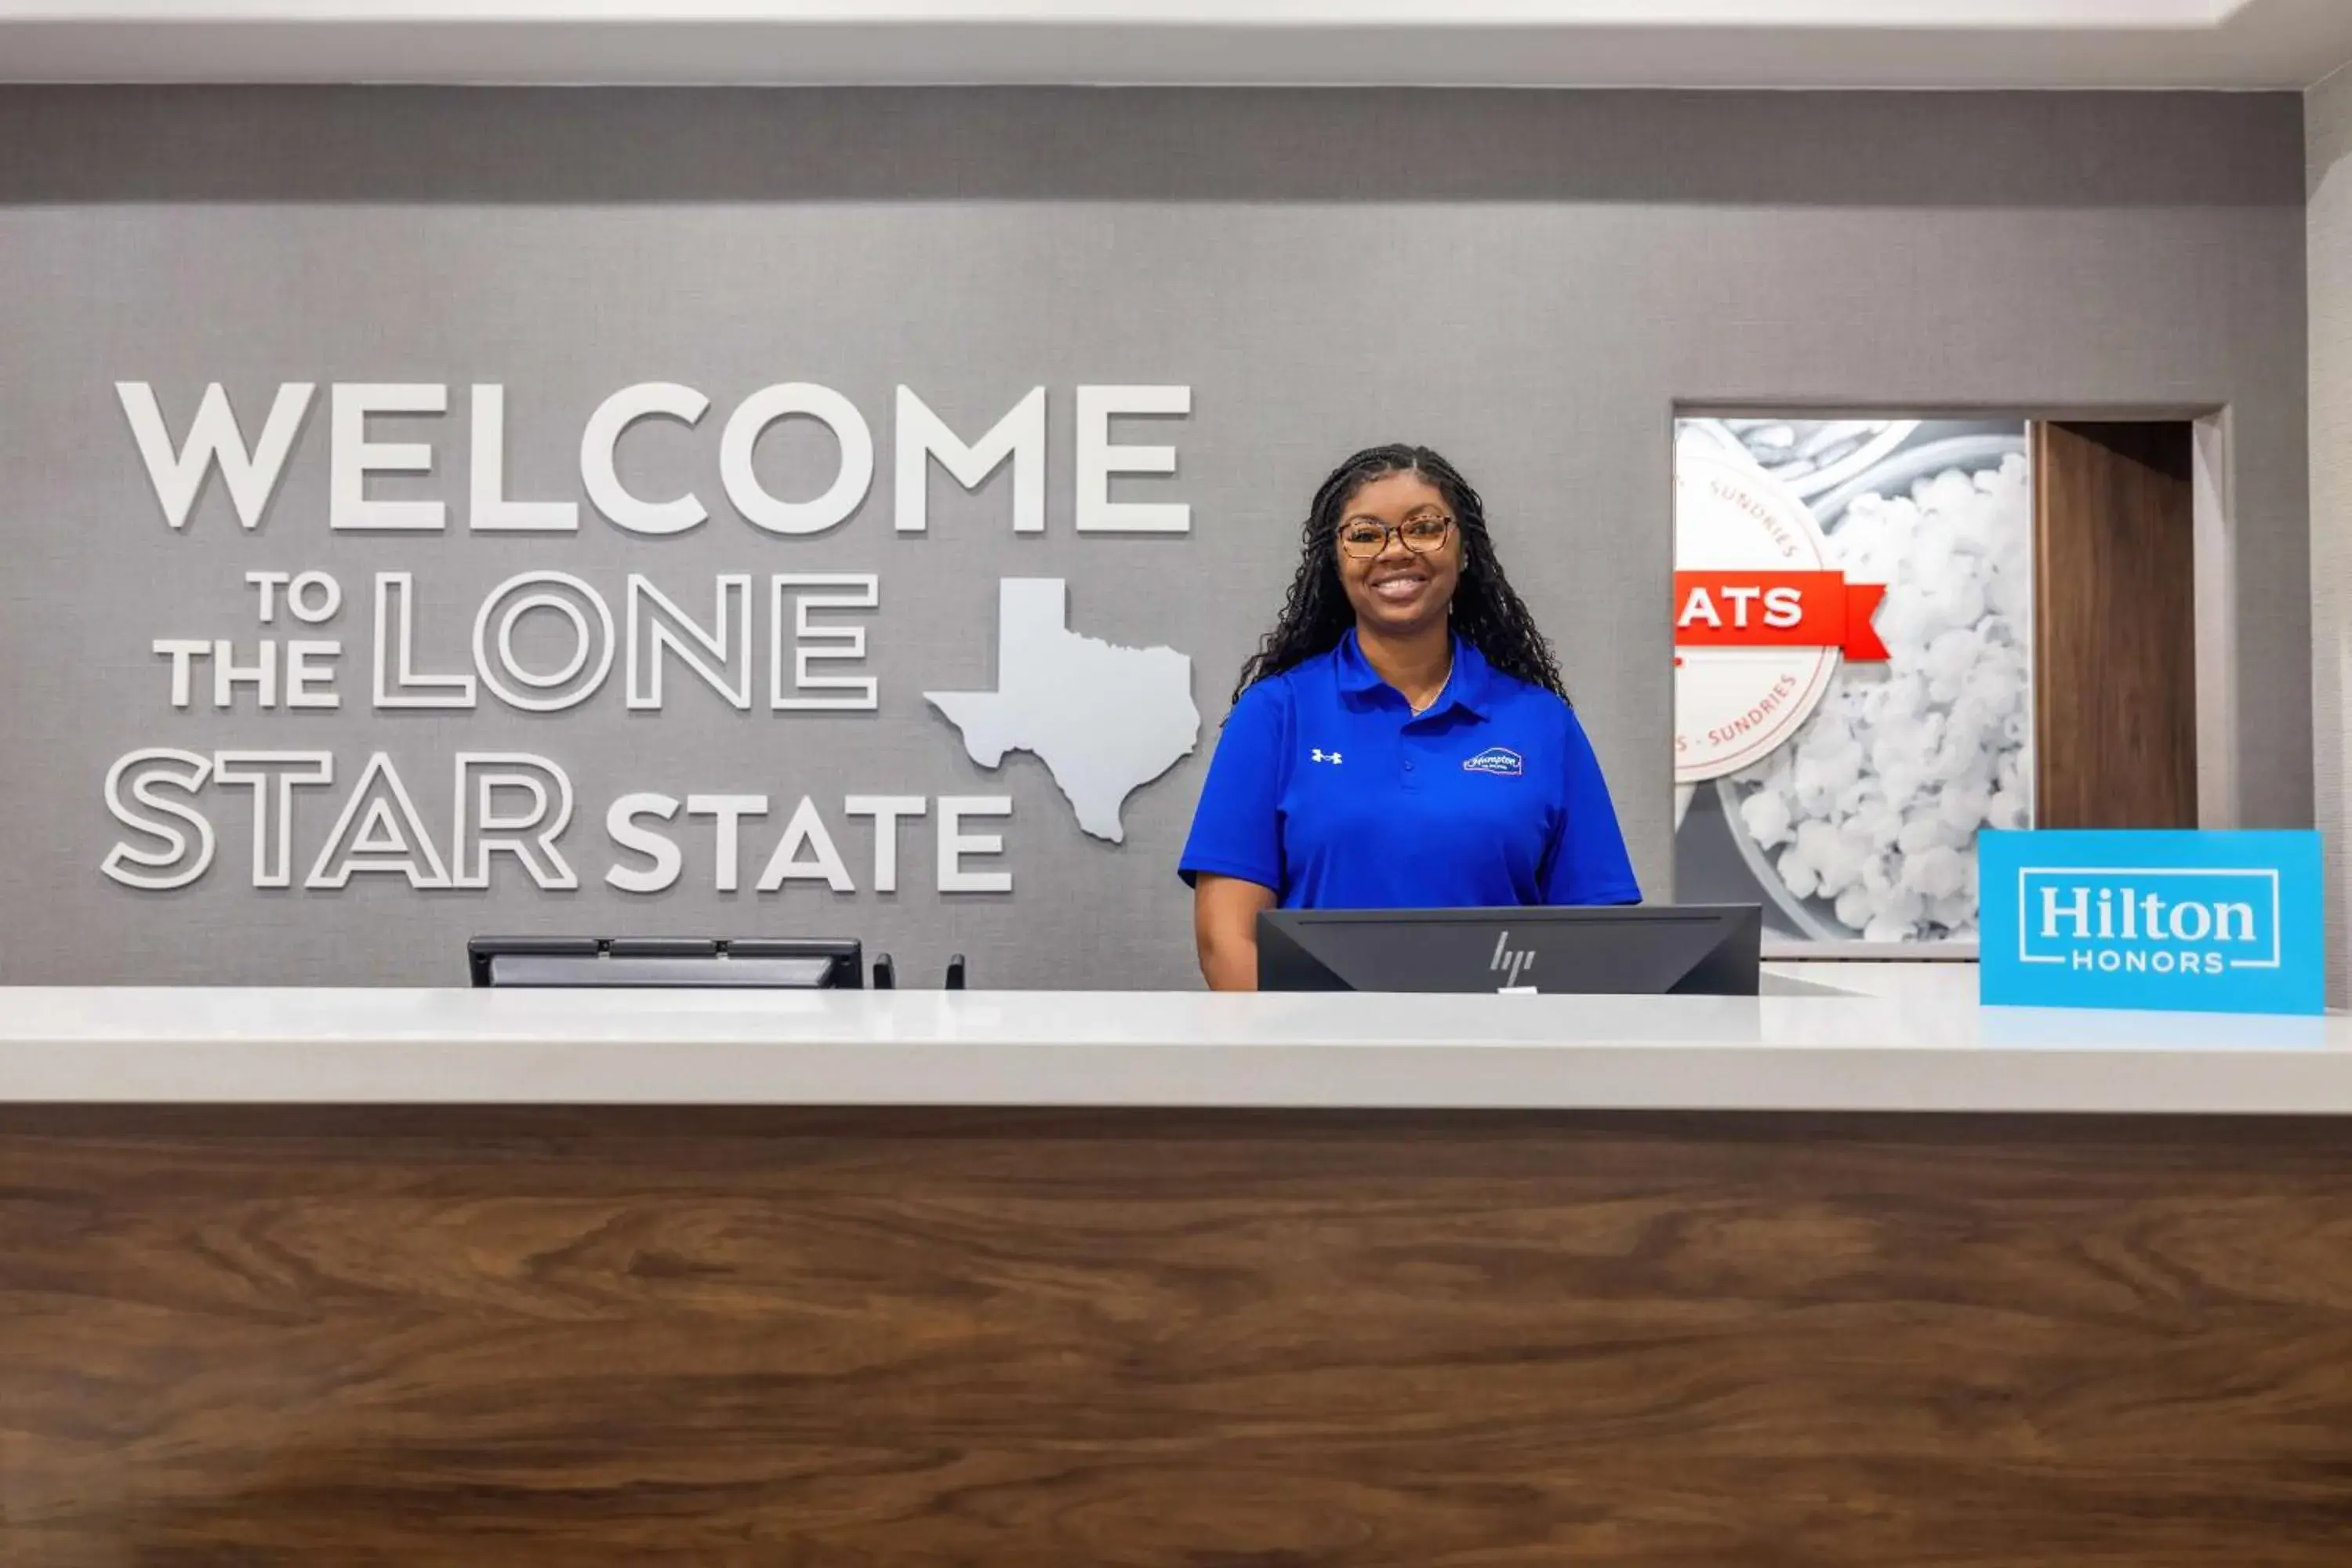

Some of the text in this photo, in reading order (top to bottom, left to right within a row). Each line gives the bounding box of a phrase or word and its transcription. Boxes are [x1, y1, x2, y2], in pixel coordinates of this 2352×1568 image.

[114, 381, 1191, 535] WELCOME
[1710, 479, 1798, 557] SUNDRIES
[245, 570, 342, 622] TO
[1677, 586, 1802, 628] ATS
[152, 570, 879, 711] THE LONE
[1708, 673, 1797, 746] SUNDRIES
[100, 747, 1013, 892] STAR STATE
[2040, 887, 2256, 941] Hilton
[1490, 931, 1536, 988] hp
[2072, 949, 2223, 975] HONORS
